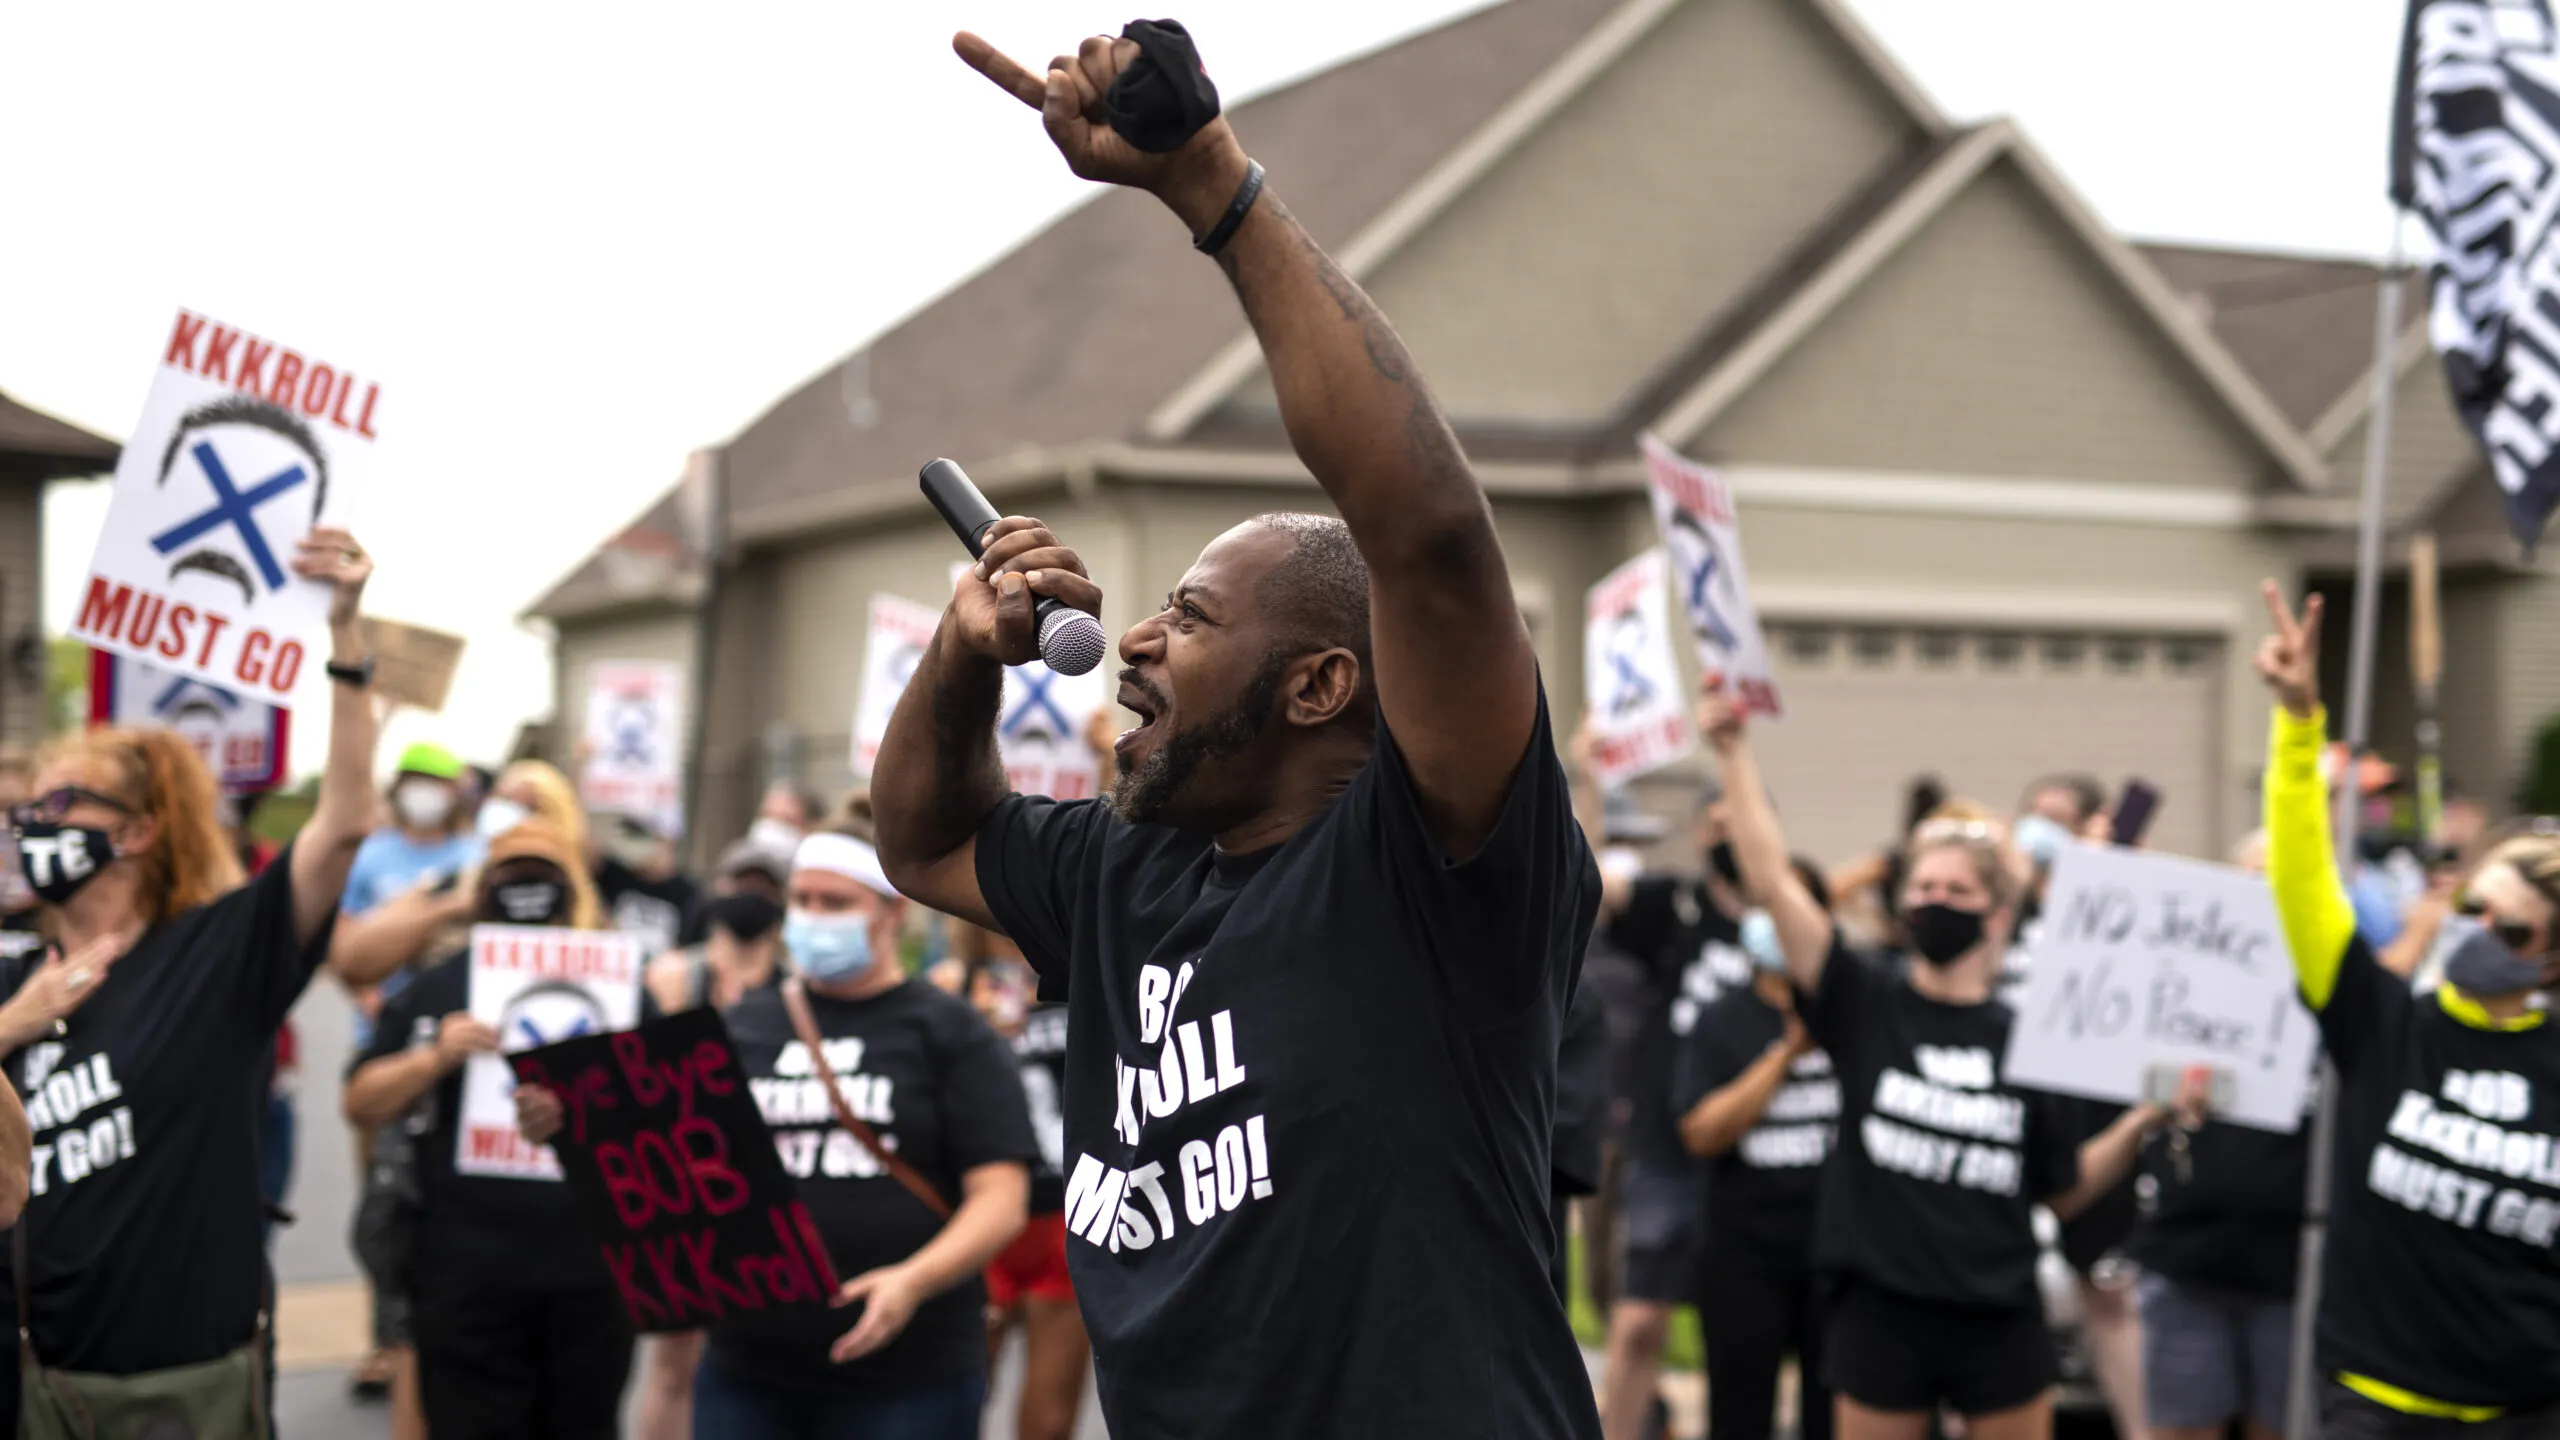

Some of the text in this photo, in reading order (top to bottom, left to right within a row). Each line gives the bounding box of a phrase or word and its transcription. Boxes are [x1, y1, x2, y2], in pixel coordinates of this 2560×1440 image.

[166, 311, 382, 440] KKKROLL
[76, 576, 305, 693] MUST GO
[611, 1031, 734, 1122] Bye
[57, 1106, 136, 1183] GO!
[595, 1117, 750, 1230] BOB
[1065, 1152, 1174, 1253] MST
[1179, 1114, 1273, 1226] GO!
[2367, 1142, 2496, 1229] MUST
